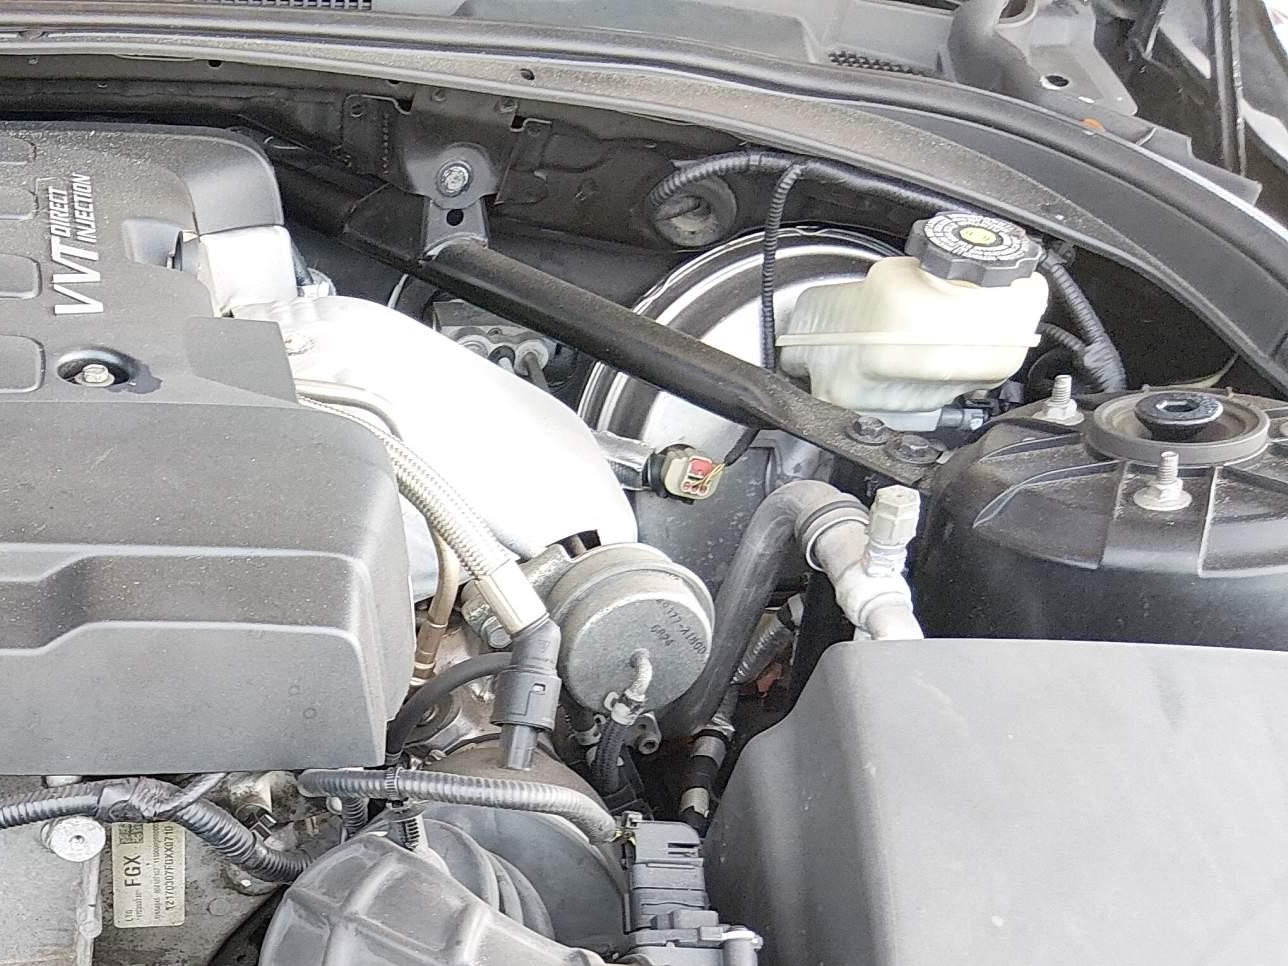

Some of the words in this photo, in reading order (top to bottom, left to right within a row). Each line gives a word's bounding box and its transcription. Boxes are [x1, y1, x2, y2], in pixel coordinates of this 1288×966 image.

[48, 186, 71, 237] DIRECT
[72, 172, 97, 243] INJECTION
[52, 236, 103, 314] VVT
[123, 855, 141, 887] FGX
